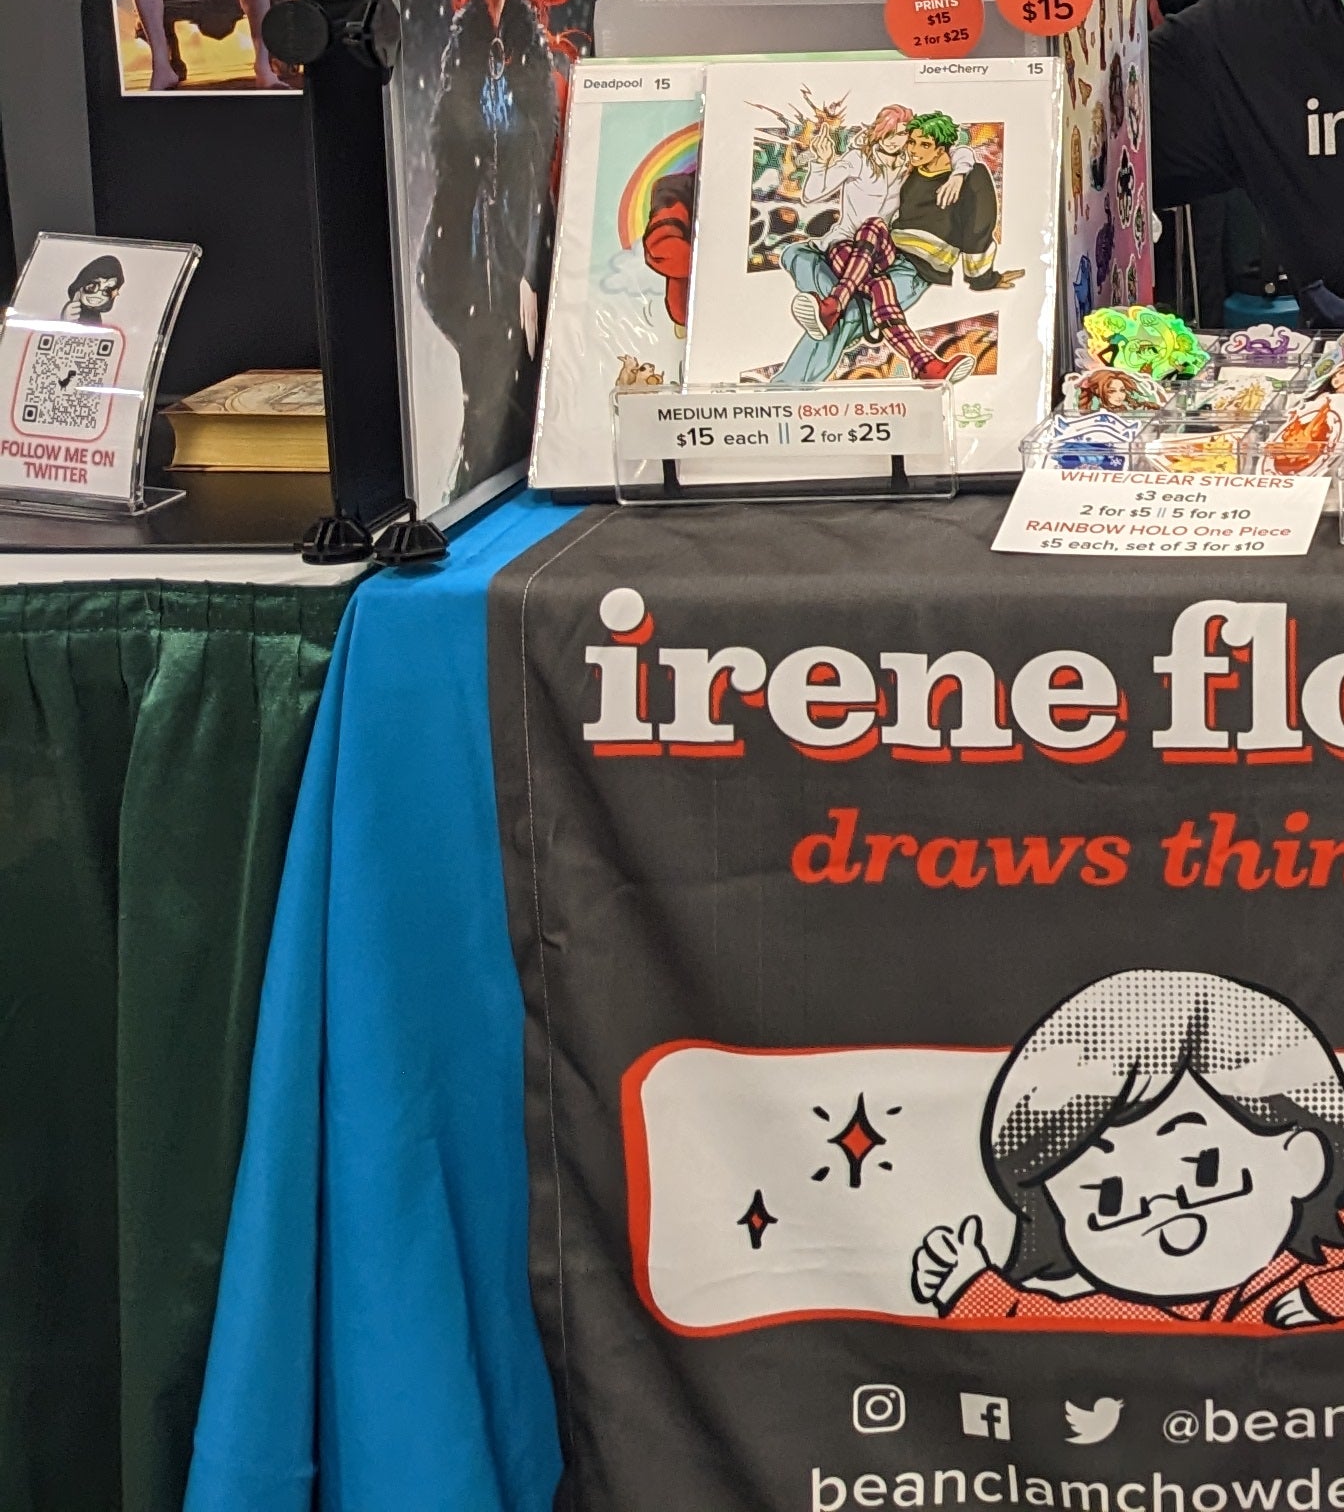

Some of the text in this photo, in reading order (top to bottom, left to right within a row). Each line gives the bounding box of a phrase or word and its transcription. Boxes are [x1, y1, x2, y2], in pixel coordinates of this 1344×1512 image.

[927, 11, 951, 26] $15
[924, 28, 969, 45] for $25
[919, 63, 1044, 76] Joe+Cherry 15
[584, 77, 671, 90] Deadpool 15
[658, 402, 907, 421] MEDIUM PRINTS (8x10 8.5x11)
[676, 423, 891, 447] $15 each 2 for $25
[1, 440, 115, 467] FOLLOW ME ON
[23, 461, 88, 484] TWITTER
[1061, 471, 1294, 489] WHITE/CLEAR STICKERS
[1135, 490, 1207, 503] $3 each
[1080, 505, 1251, 520] 2 for $5 5 for $10
[1026, 520, 1292, 537] RAINBOW HOLO One Piece
[1040, 539, 1265, 552] $5 each, set of 3 for $10
[582, 588, 1128, 763] irene
[791, 810, 1131, 890] draws
